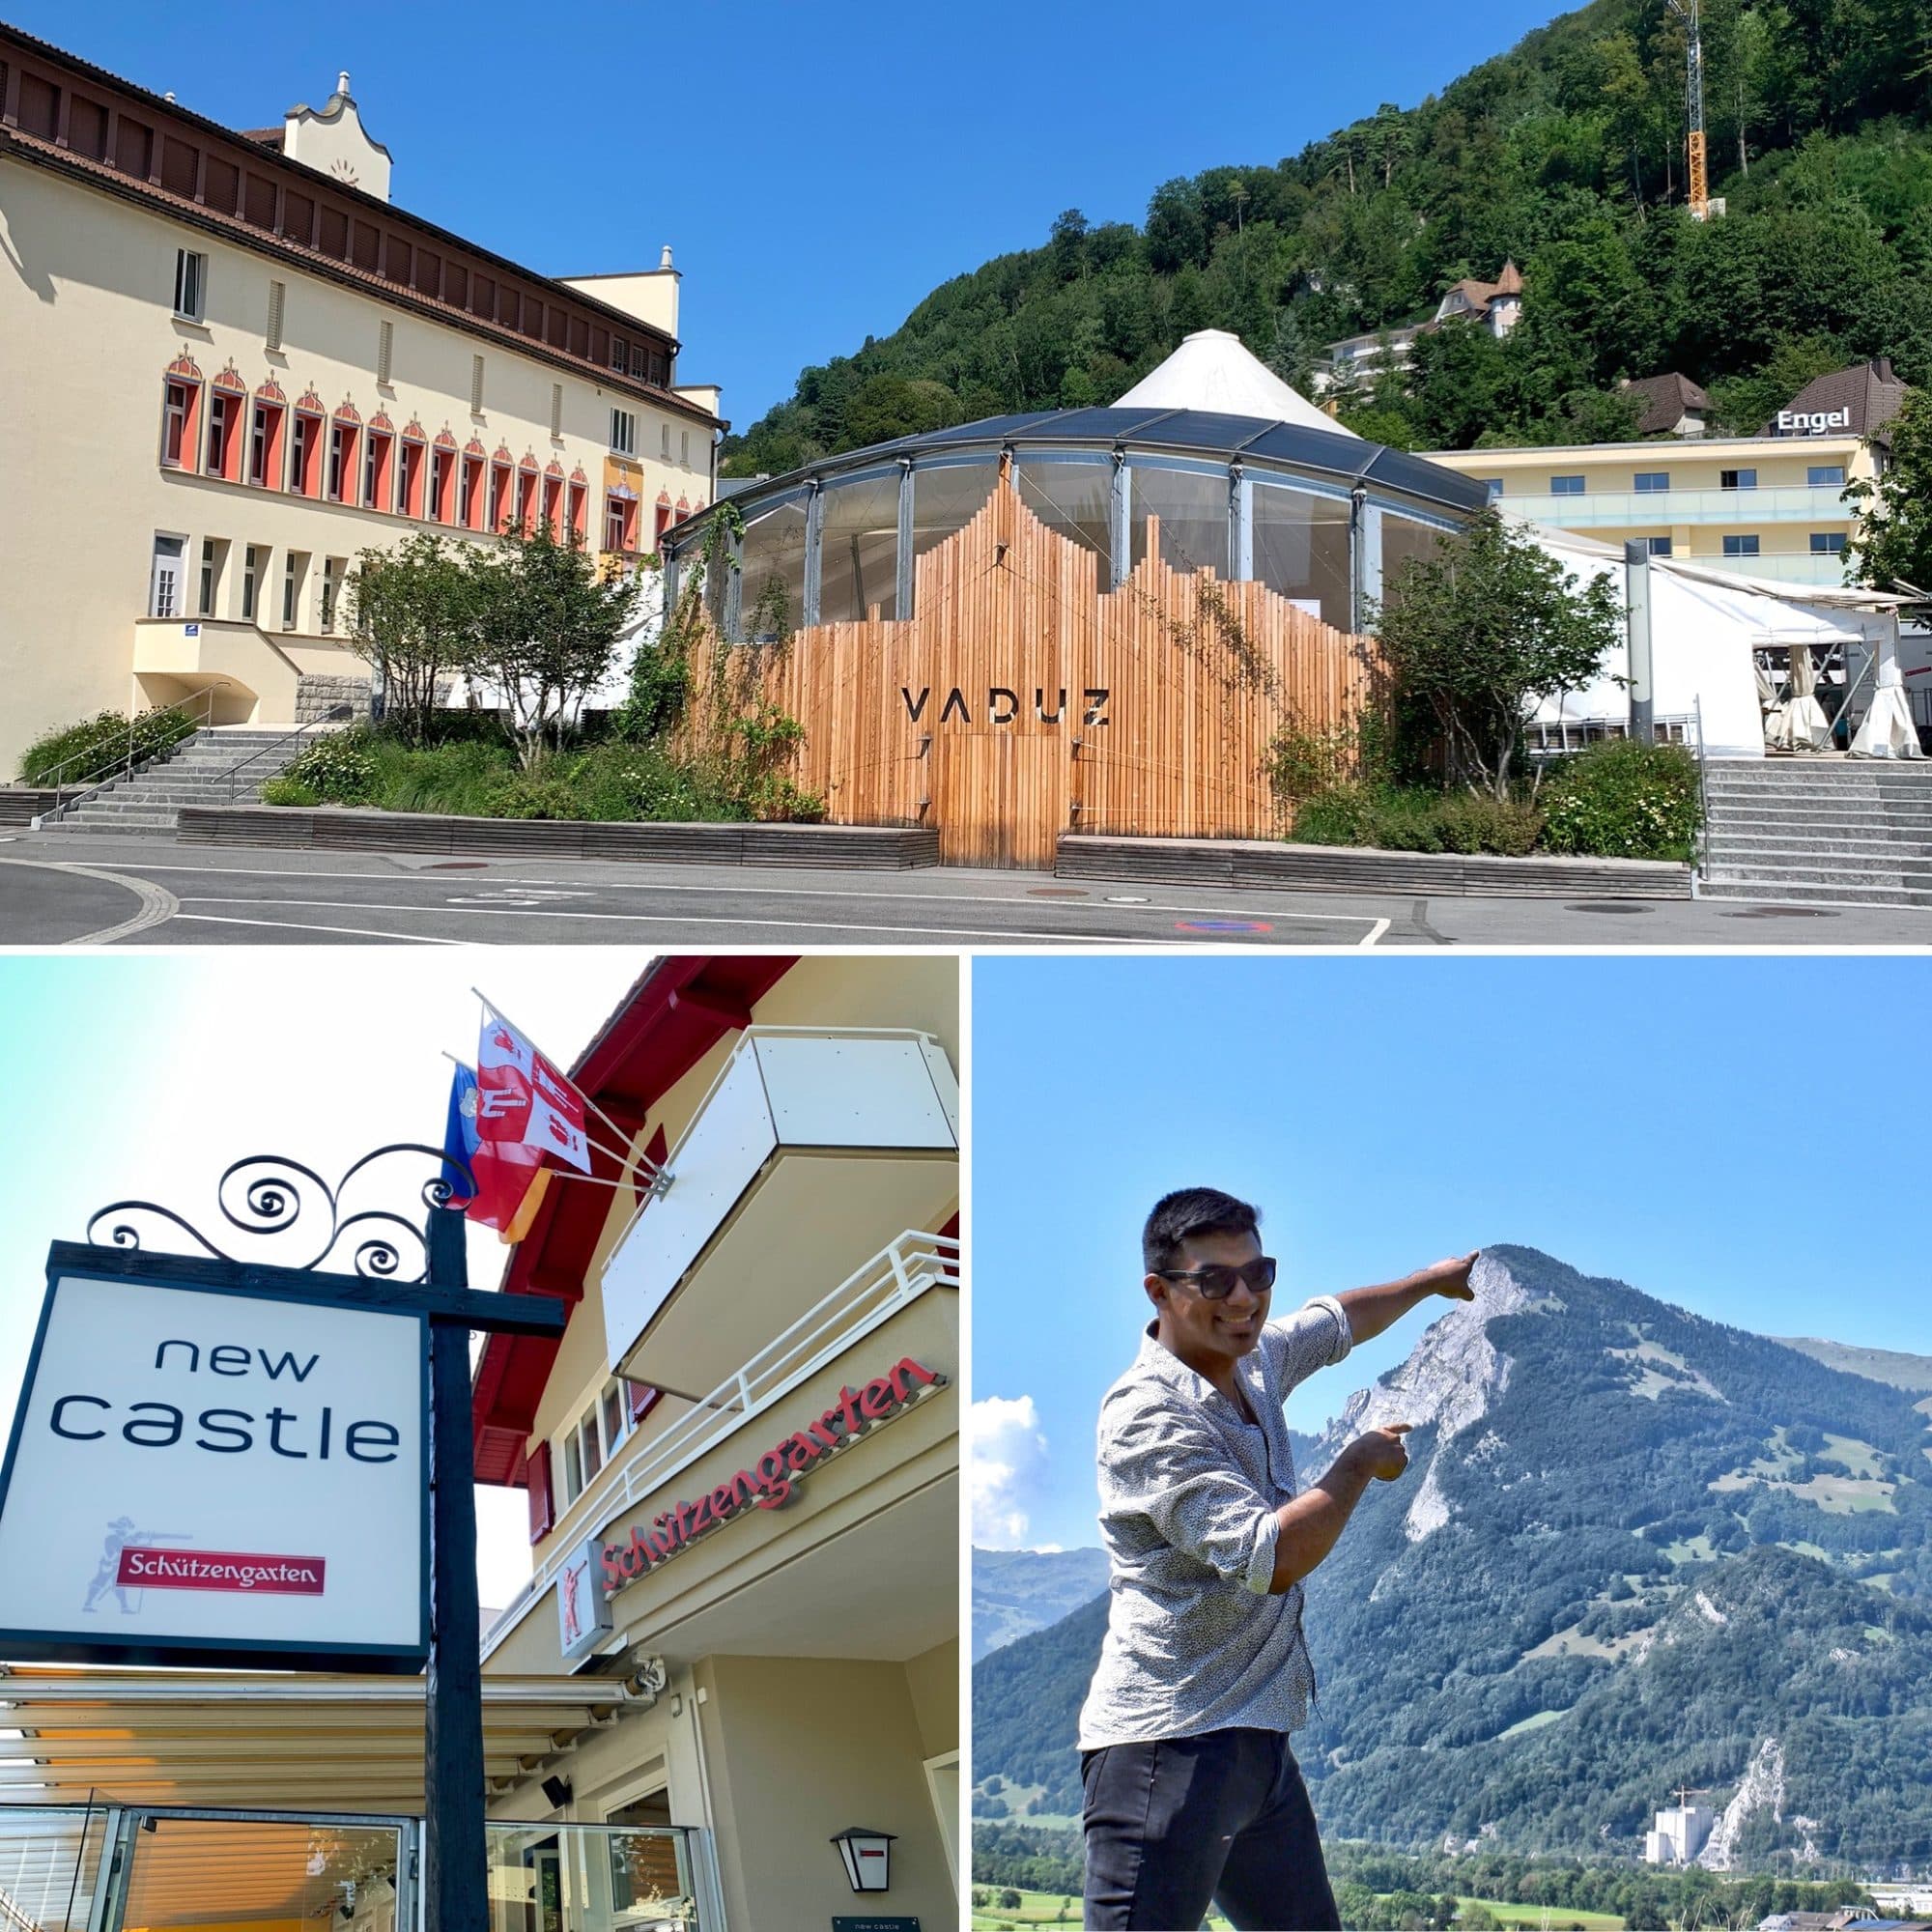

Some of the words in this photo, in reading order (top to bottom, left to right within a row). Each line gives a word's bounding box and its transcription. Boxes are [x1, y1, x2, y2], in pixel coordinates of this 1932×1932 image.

[1777, 407, 1849, 433] Engel
[901, 687, 1110, 725] VADUZ
[155, 1339, 320, 1382] new
[49, 1394, 400, 1463] castle
[602, 1356, 941, 1591] Schützengarten
[128, 1553, 318, 1588] Schützengarten
